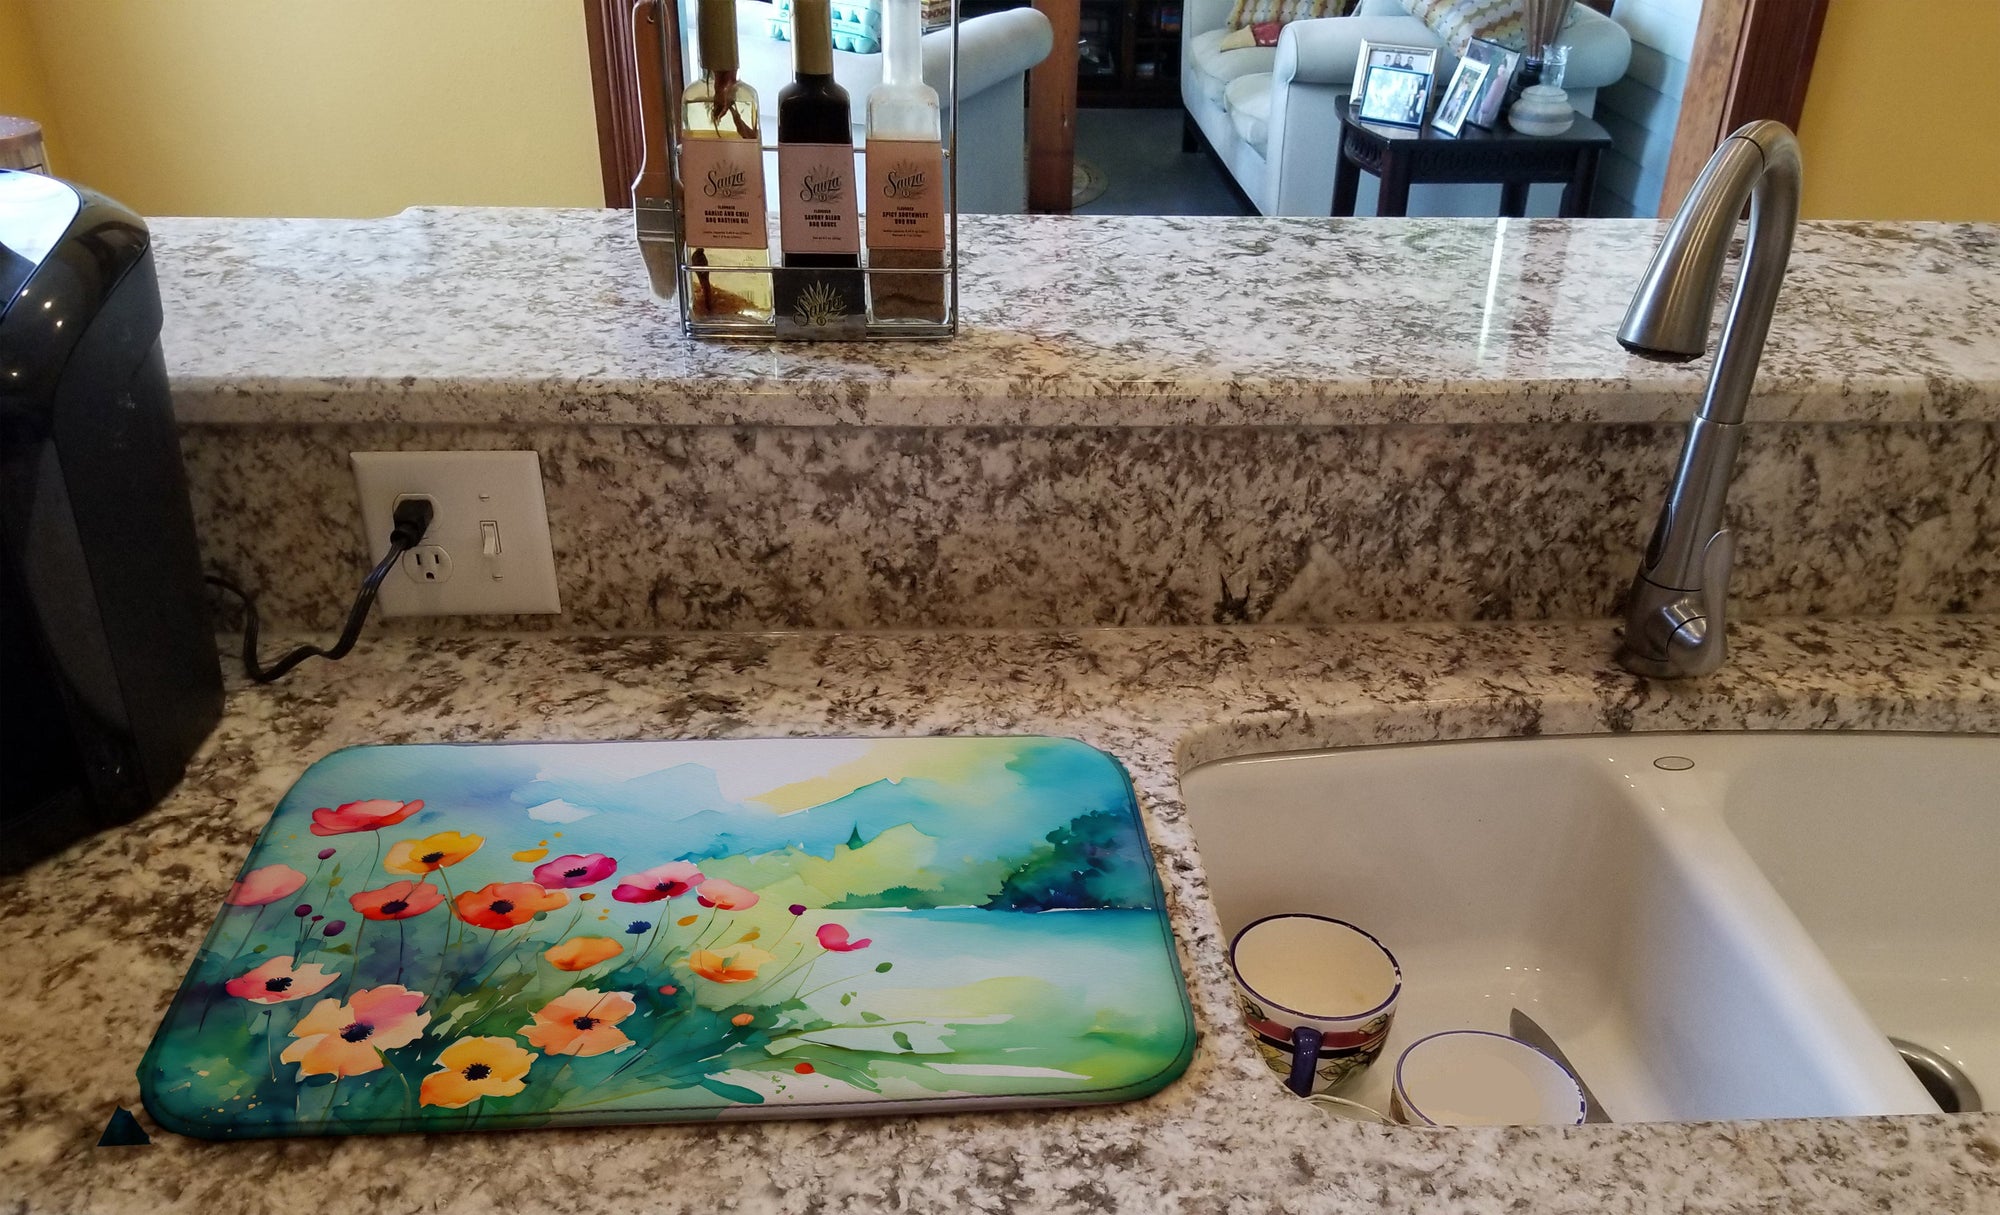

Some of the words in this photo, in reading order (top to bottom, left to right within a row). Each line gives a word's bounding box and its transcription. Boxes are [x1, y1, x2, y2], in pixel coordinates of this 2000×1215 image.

[704, 170, 745, 197] Sauza
[800, 176, 841, 202] Sauza
[884, 171, 924, 198] Sauza
[793, 295, 843, 327] Sauza
